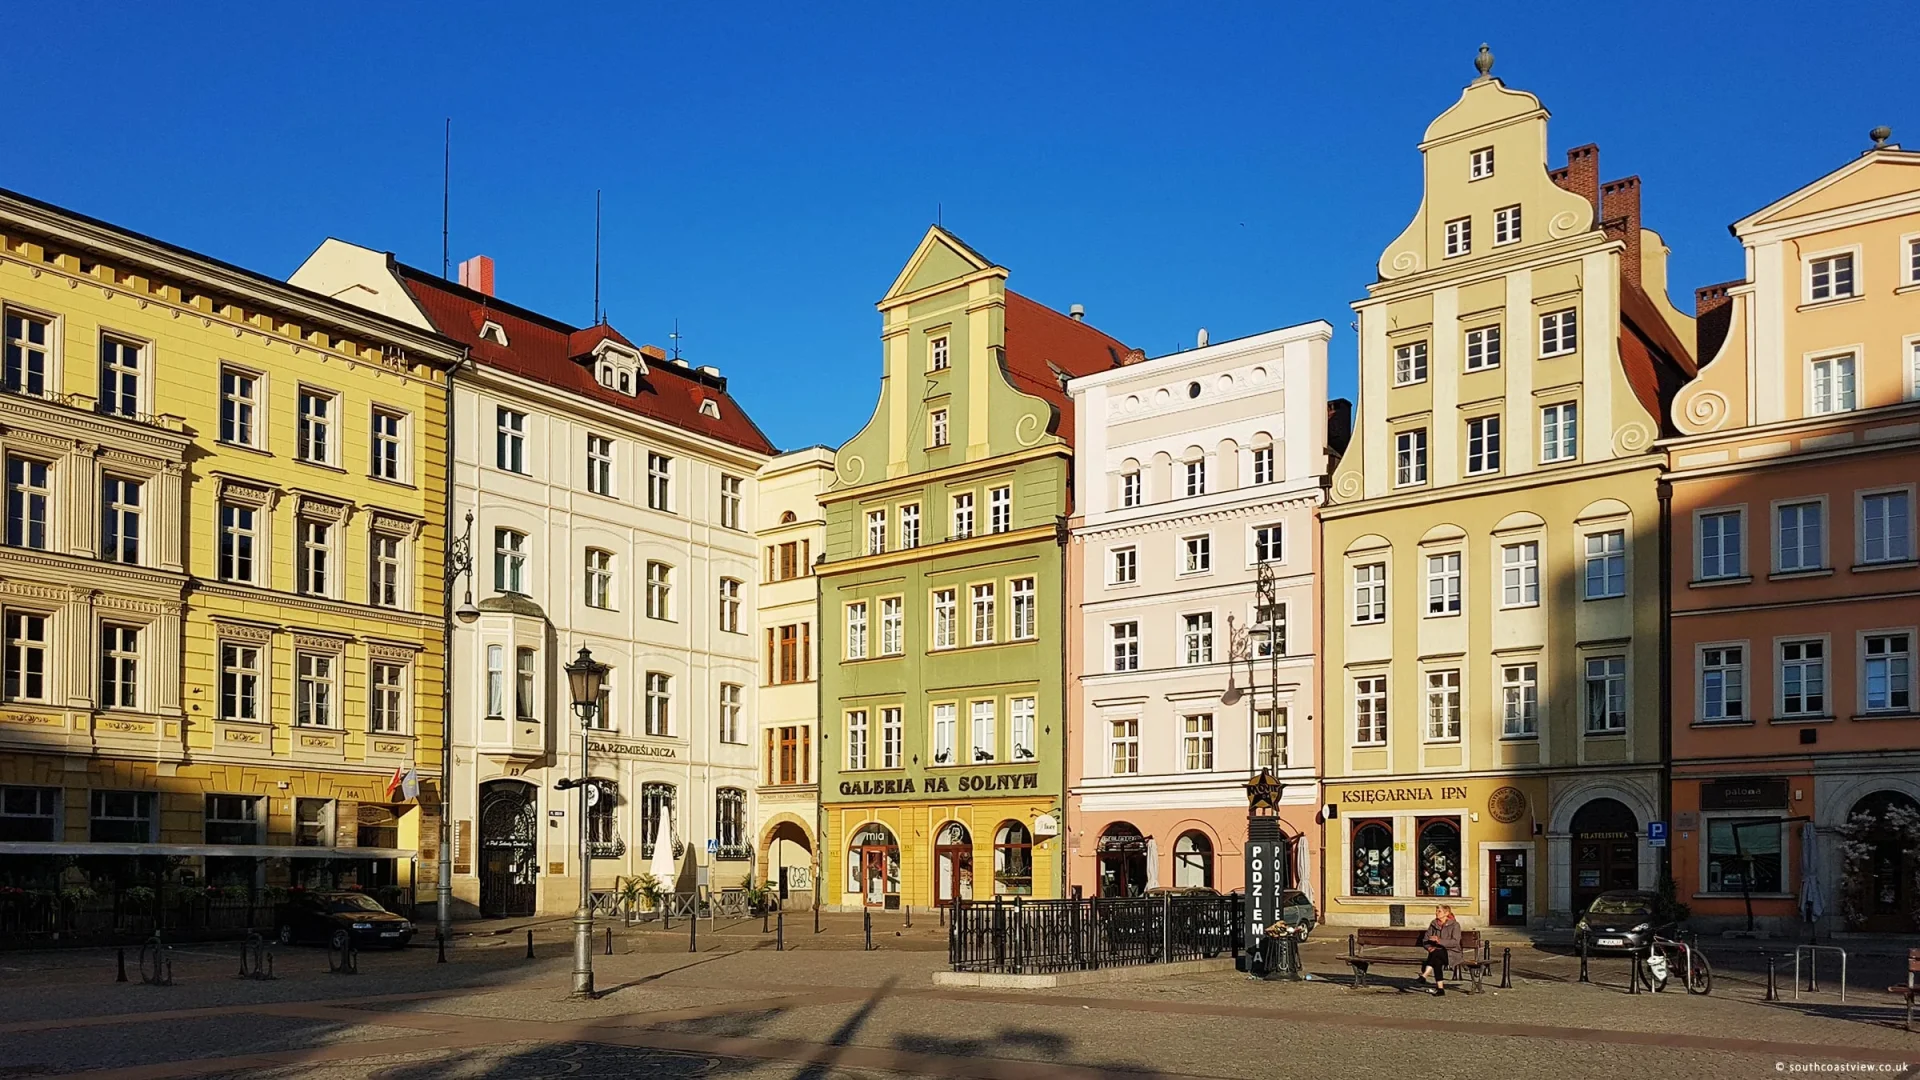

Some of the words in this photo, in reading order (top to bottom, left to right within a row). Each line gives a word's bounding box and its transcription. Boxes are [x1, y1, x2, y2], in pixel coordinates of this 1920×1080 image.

[588, 742, 606, 752] ZBA
[608, 743, 676, 758] RZEMIEŚLNICZA
[509, 767, 520, 776] 13
[839, 778, 915, 795] GALERIA
[924, 777, 949, 793] NA
[958, 772, 1038, 792] SOLNYM
[346, 790, 359, 799] 14A
[1342, 788, 1433, 804] KSIĘGARNIA
[1441, 786, 1468, 799] IPN
[866, 832, 885, 841] mia
[1652, 823, 1663, 837] P
[1251, 846, 1264, 963] PODZIEMIA
